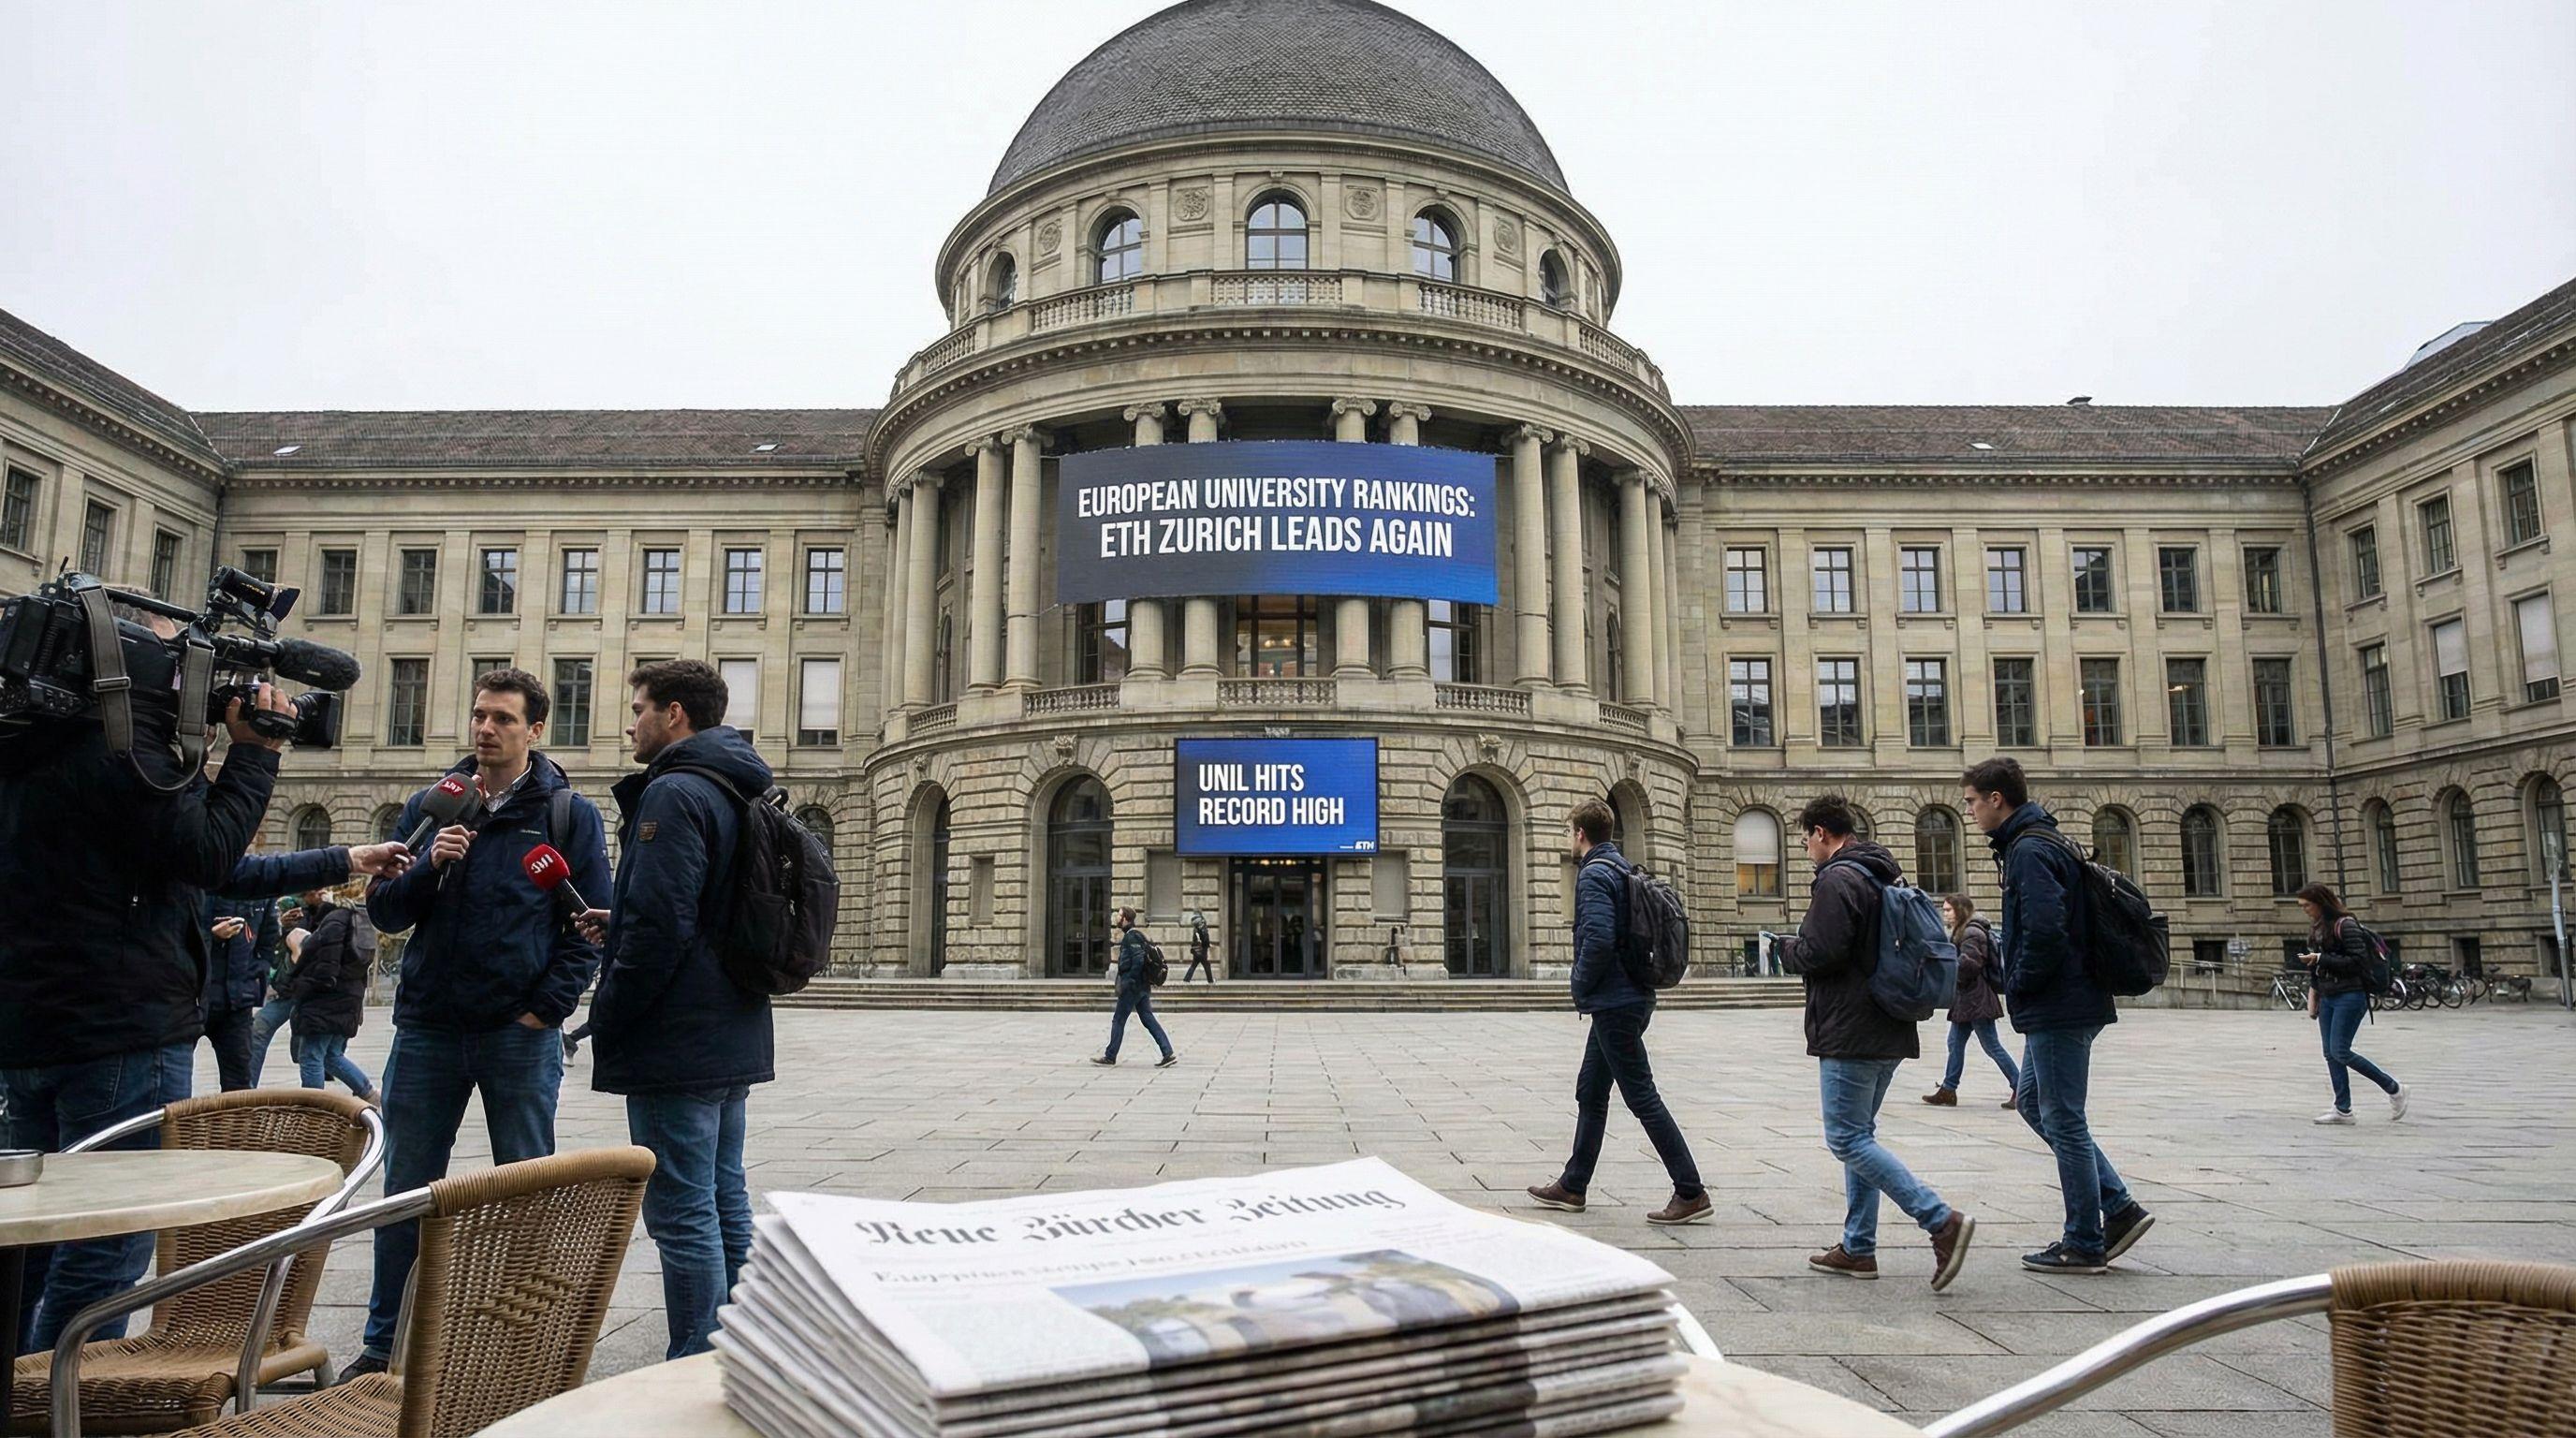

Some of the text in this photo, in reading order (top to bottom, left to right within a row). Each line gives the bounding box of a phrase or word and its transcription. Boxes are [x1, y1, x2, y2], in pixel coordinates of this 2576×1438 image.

[1078, 477, 1476, 518] EUROPEAN UNIVERSITY RANKINGS:
[1101, 516, 1453, 558] ETH ZURICH LEADS AGAIN
[1198, 764, 1305, 792] UNIL HITS
[1198, 797, 1344, 825] RECORD HIGH
[855, 1189, 1407, 1245] Neue Zürcher Zeitung
